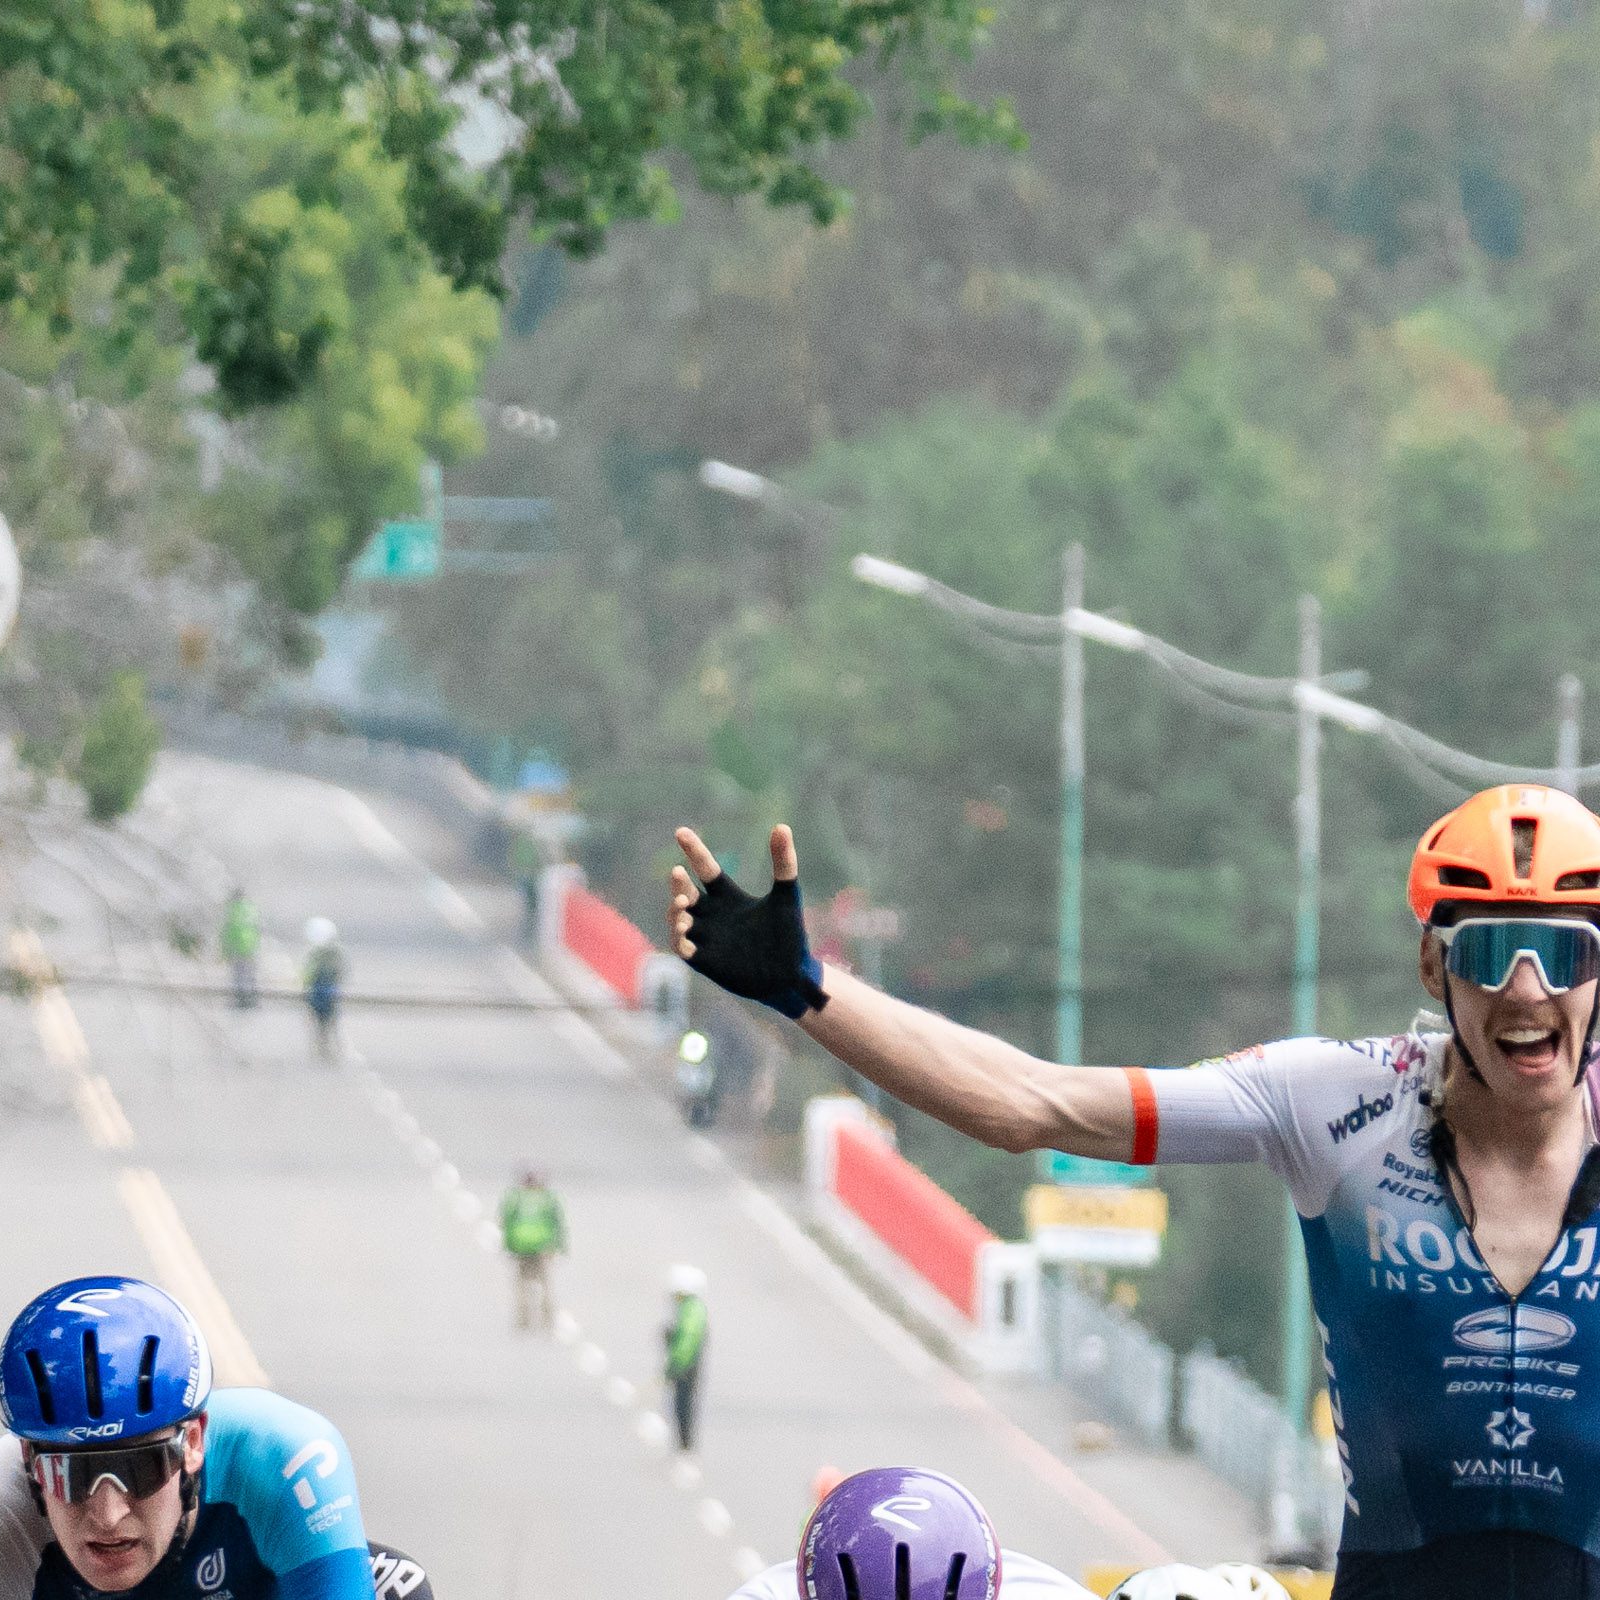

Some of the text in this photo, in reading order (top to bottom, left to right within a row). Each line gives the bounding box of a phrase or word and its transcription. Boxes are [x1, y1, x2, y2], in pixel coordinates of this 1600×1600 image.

[1327, 1093, 1393, 1143] wahoo
[1442, 1356, 1580, 1376] PROBIKE
[1446, 1381, 1576, 1400] BONTRAGER
[1453, 1459, 1564, 1483] VANILLA
